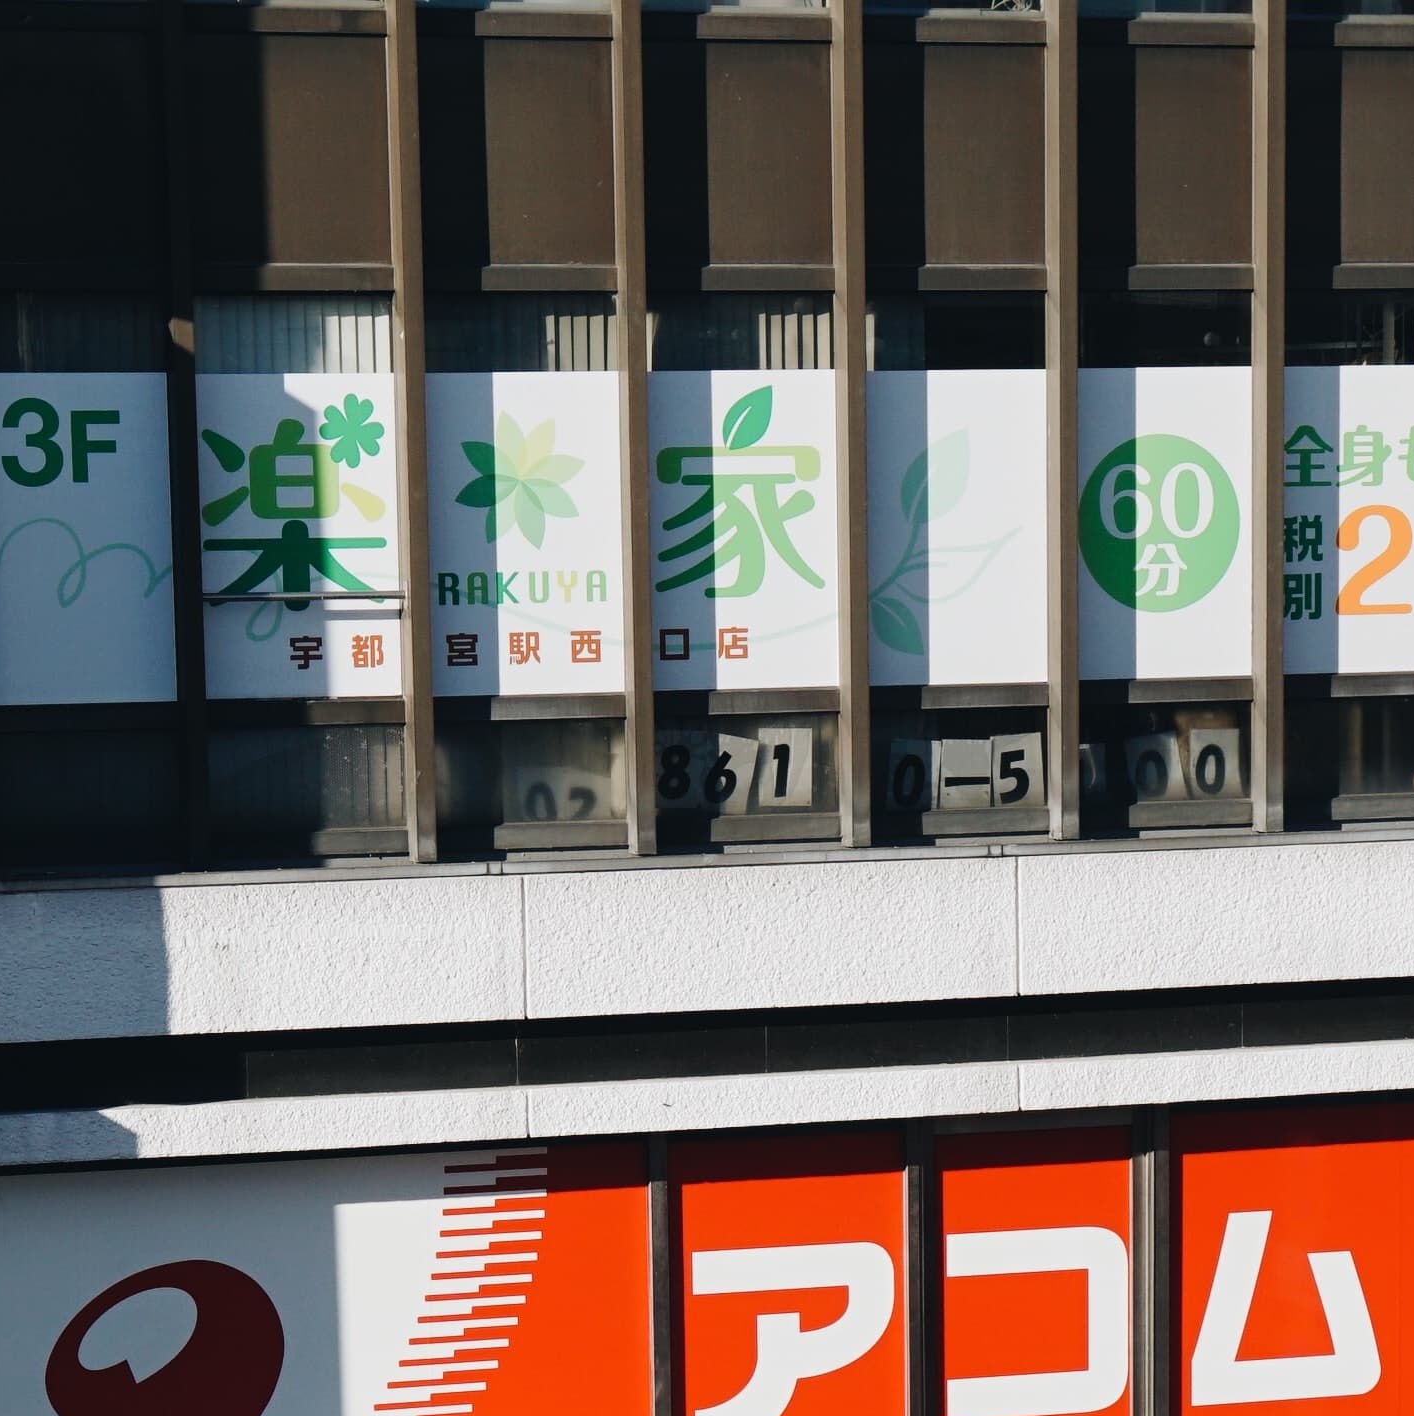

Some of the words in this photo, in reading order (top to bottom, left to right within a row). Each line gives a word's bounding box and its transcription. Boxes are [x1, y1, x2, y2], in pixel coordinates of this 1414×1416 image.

[1, 398, 121, 488] 3F
[1098, 462, 1215, 540] 60
[438, 569, 608, 606] RAKUYA
[1132, 541, 1190, 598] 分
[1282, 513, 1325, 623] 税別
[288, 627, 750, 672] 宇都宮駅西口店
